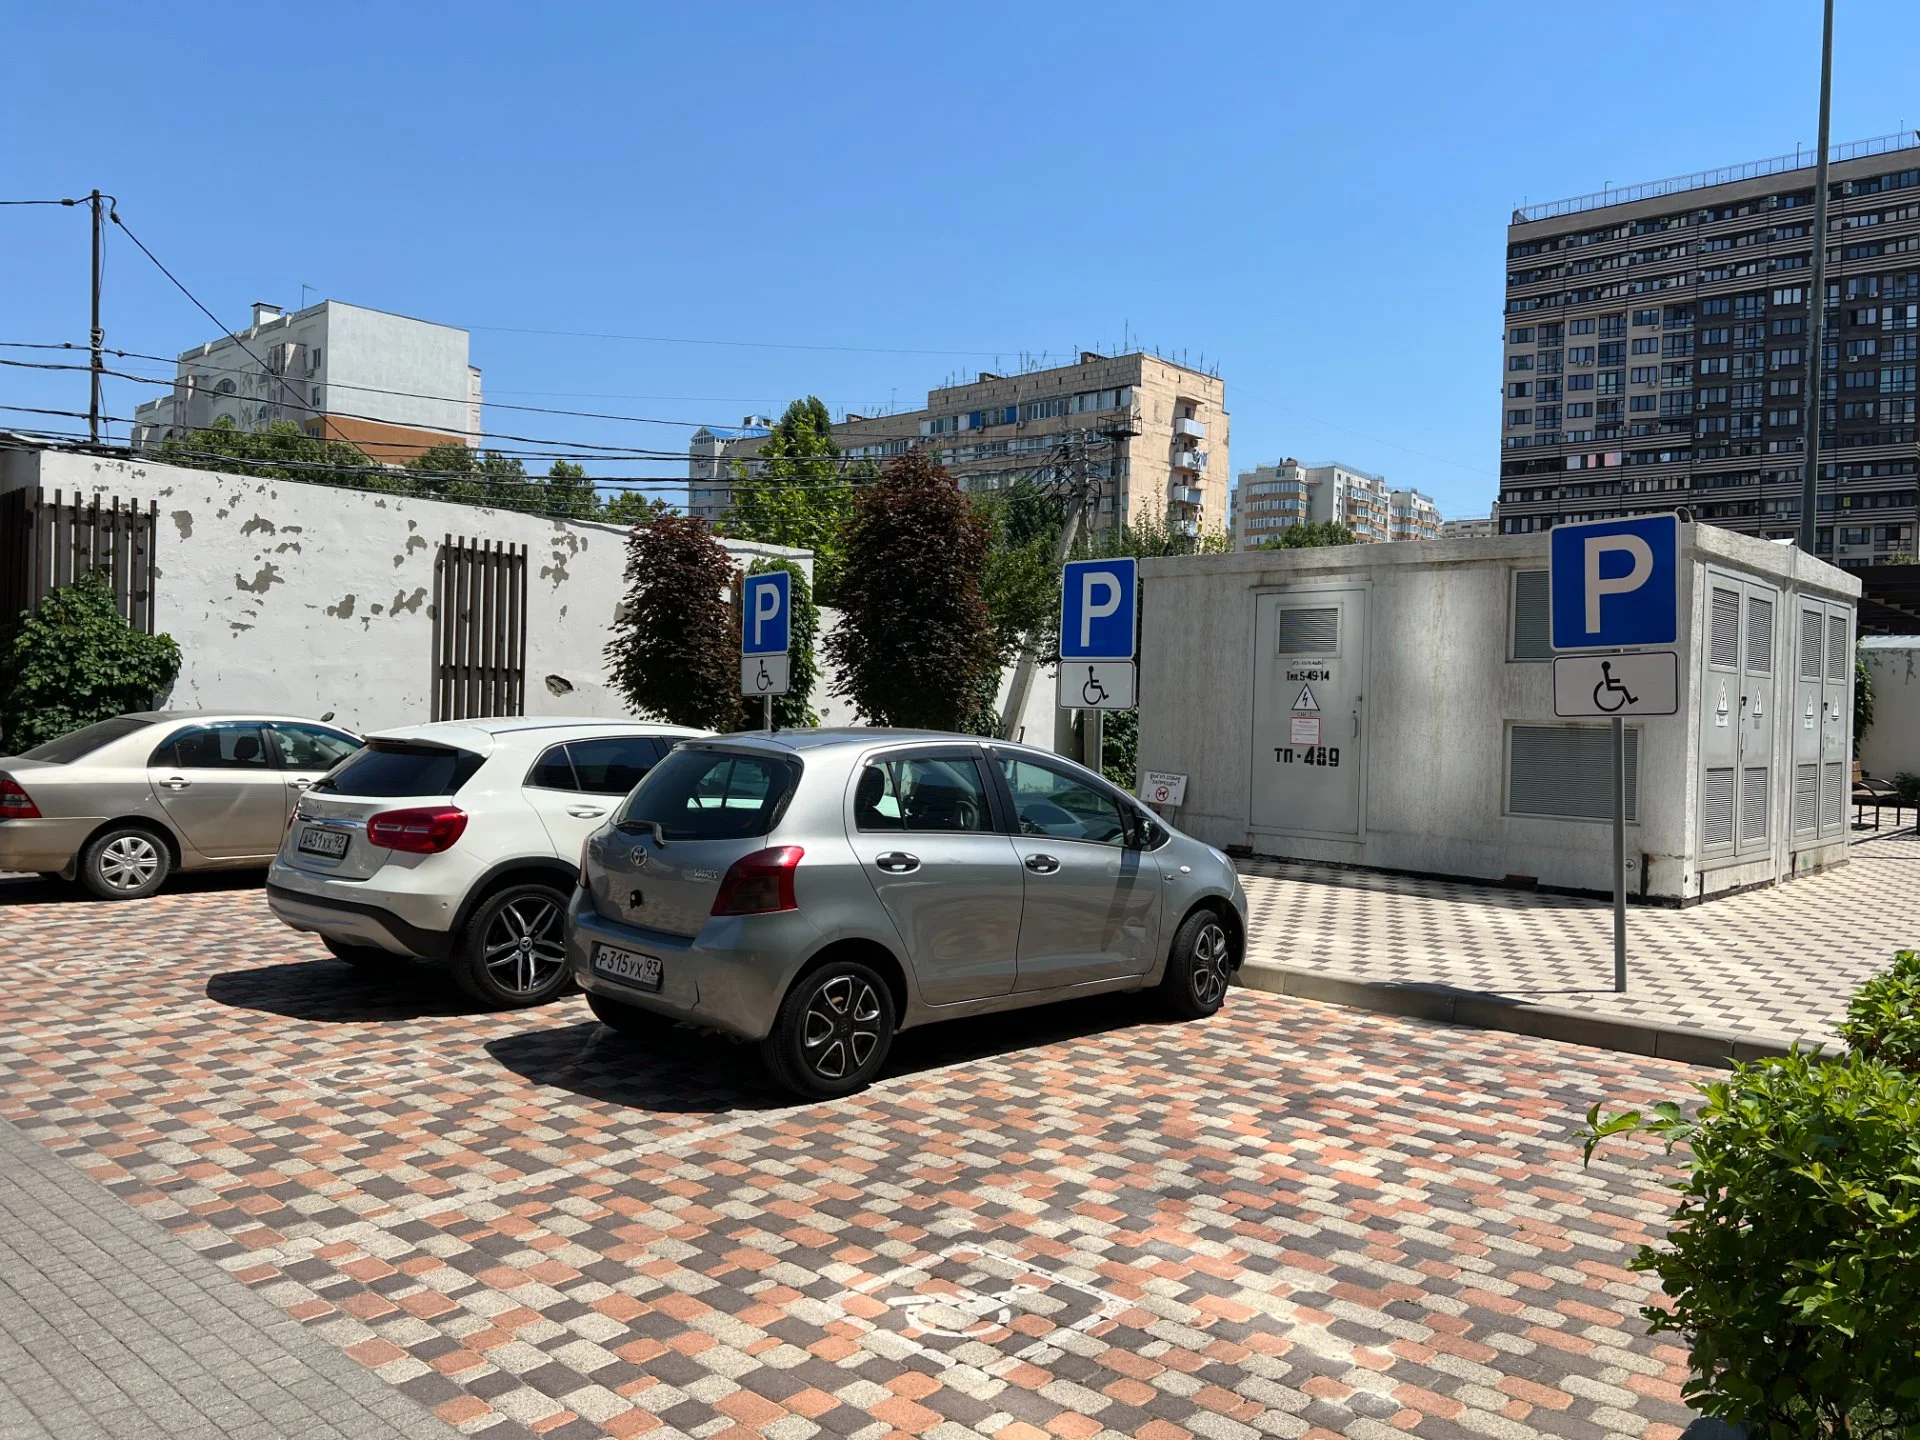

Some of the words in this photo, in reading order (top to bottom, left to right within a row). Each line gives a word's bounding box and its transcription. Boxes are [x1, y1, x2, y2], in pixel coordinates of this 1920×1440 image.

[754, 583, 781, 645] P
[1080, 571, 1121, 648] P
[1584, 534, 1654, 634] P
[646, 960, 658, 976] 93
